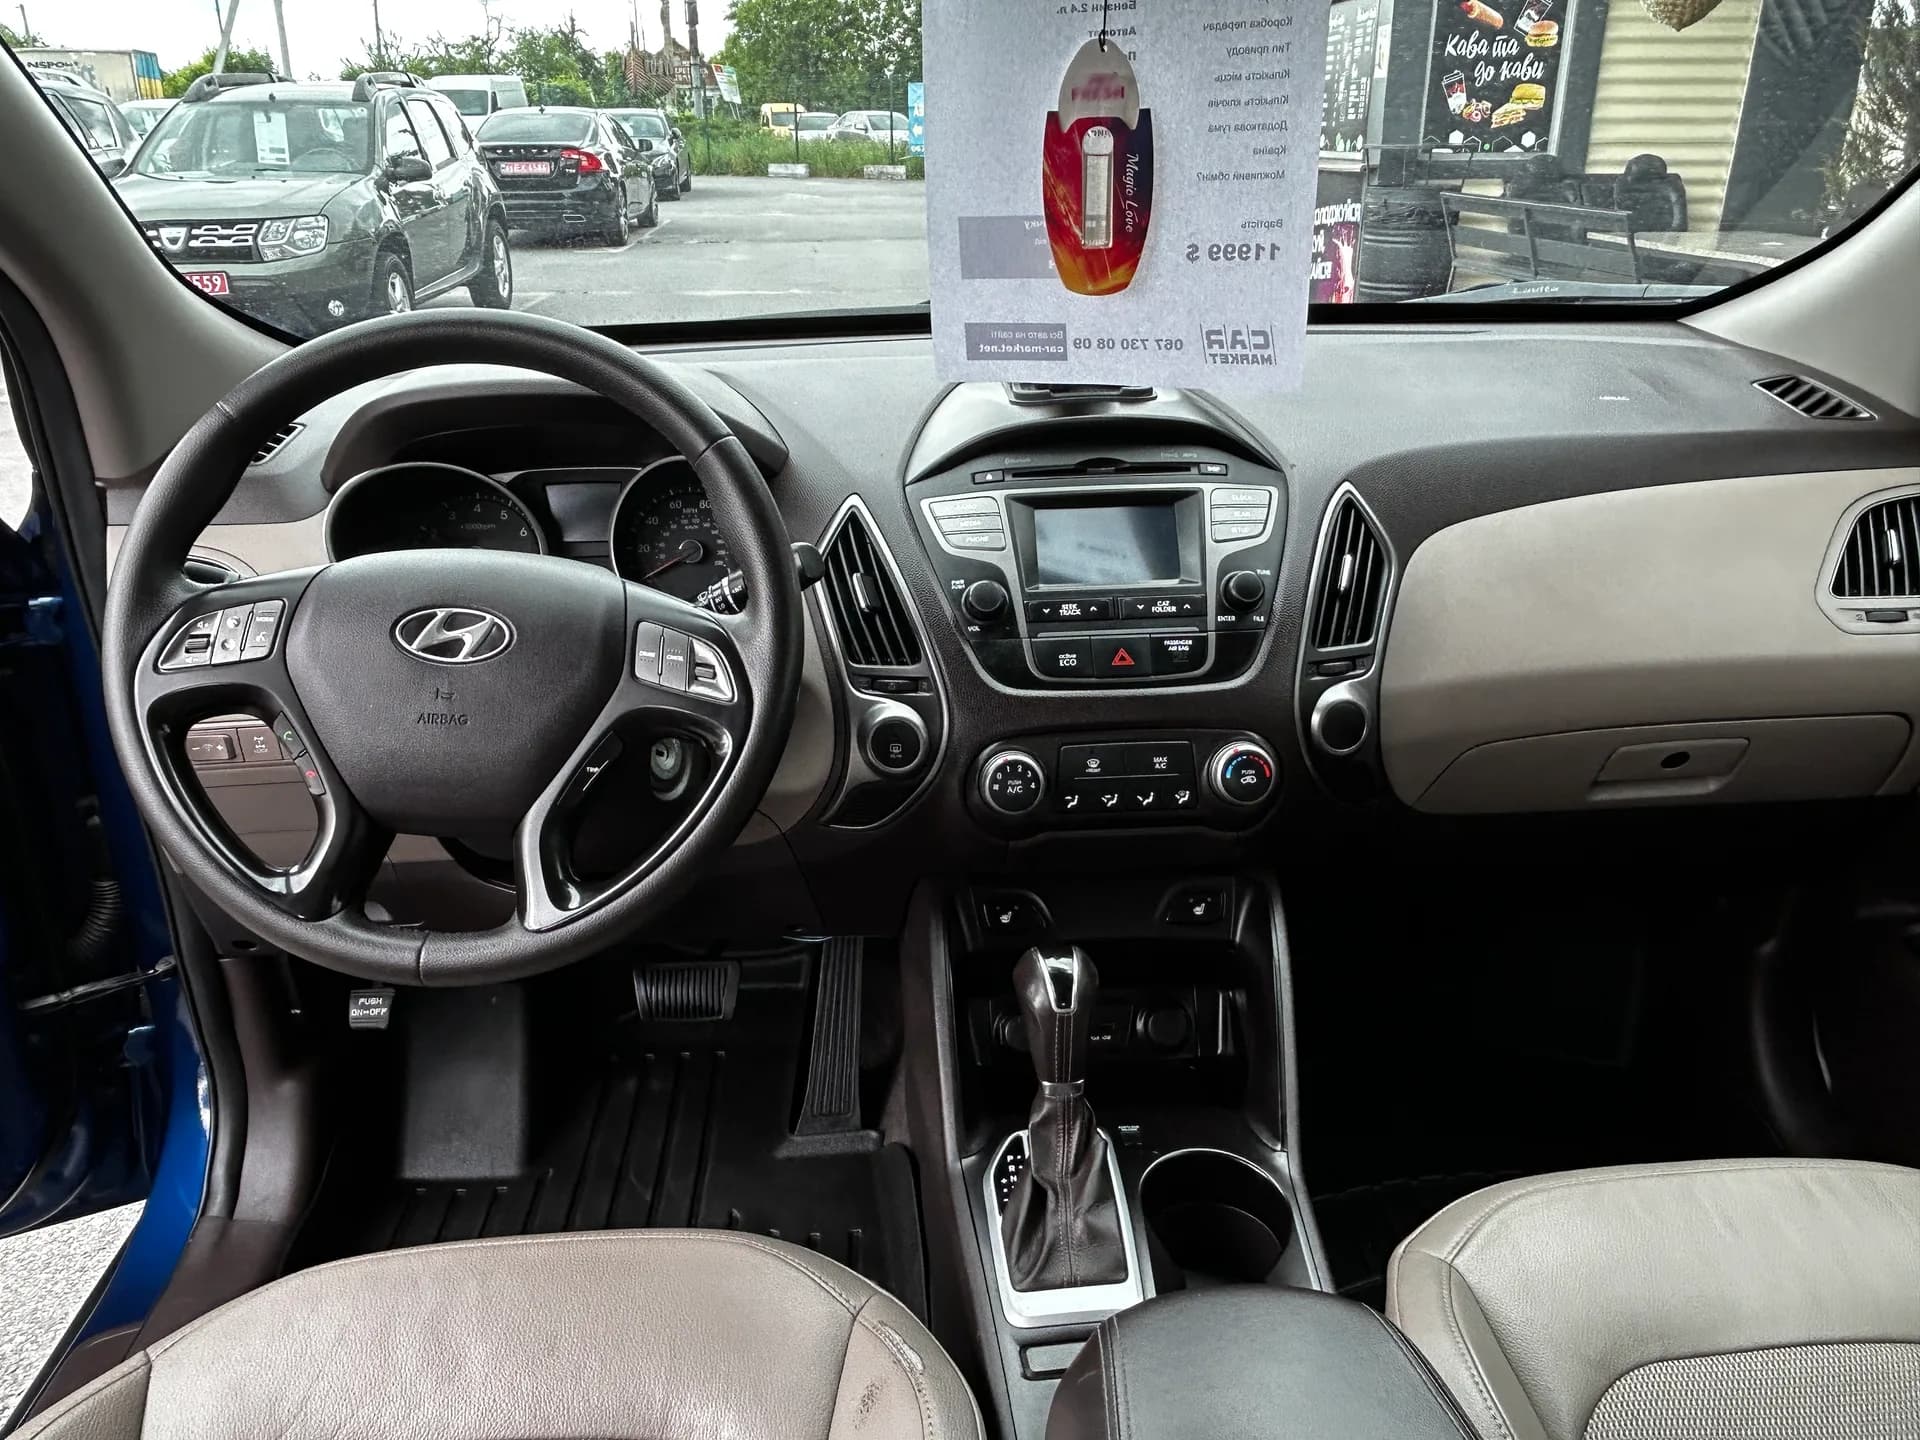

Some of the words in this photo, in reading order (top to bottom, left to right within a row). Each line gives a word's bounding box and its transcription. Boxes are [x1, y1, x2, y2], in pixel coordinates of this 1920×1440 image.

[1445, 30, 1489, 59] Кава
[1492, 35, 1520, 57] та
[1474, 60, 1496, 87] до
[1500, 53, 1544, 81] кави
[1122, 198, 1139, 233] Love
[186, 275, 221, 293] 559
[500, 510, 508, 520] 5
[520, 527, 528, 537] 6
[1059, 658, 1077, 667] ECO
[417, 712, 469, 726] AIRBAG
[1007, 785, 1024, 794] A/C
[358, 997, 383, 1006] PUSH
